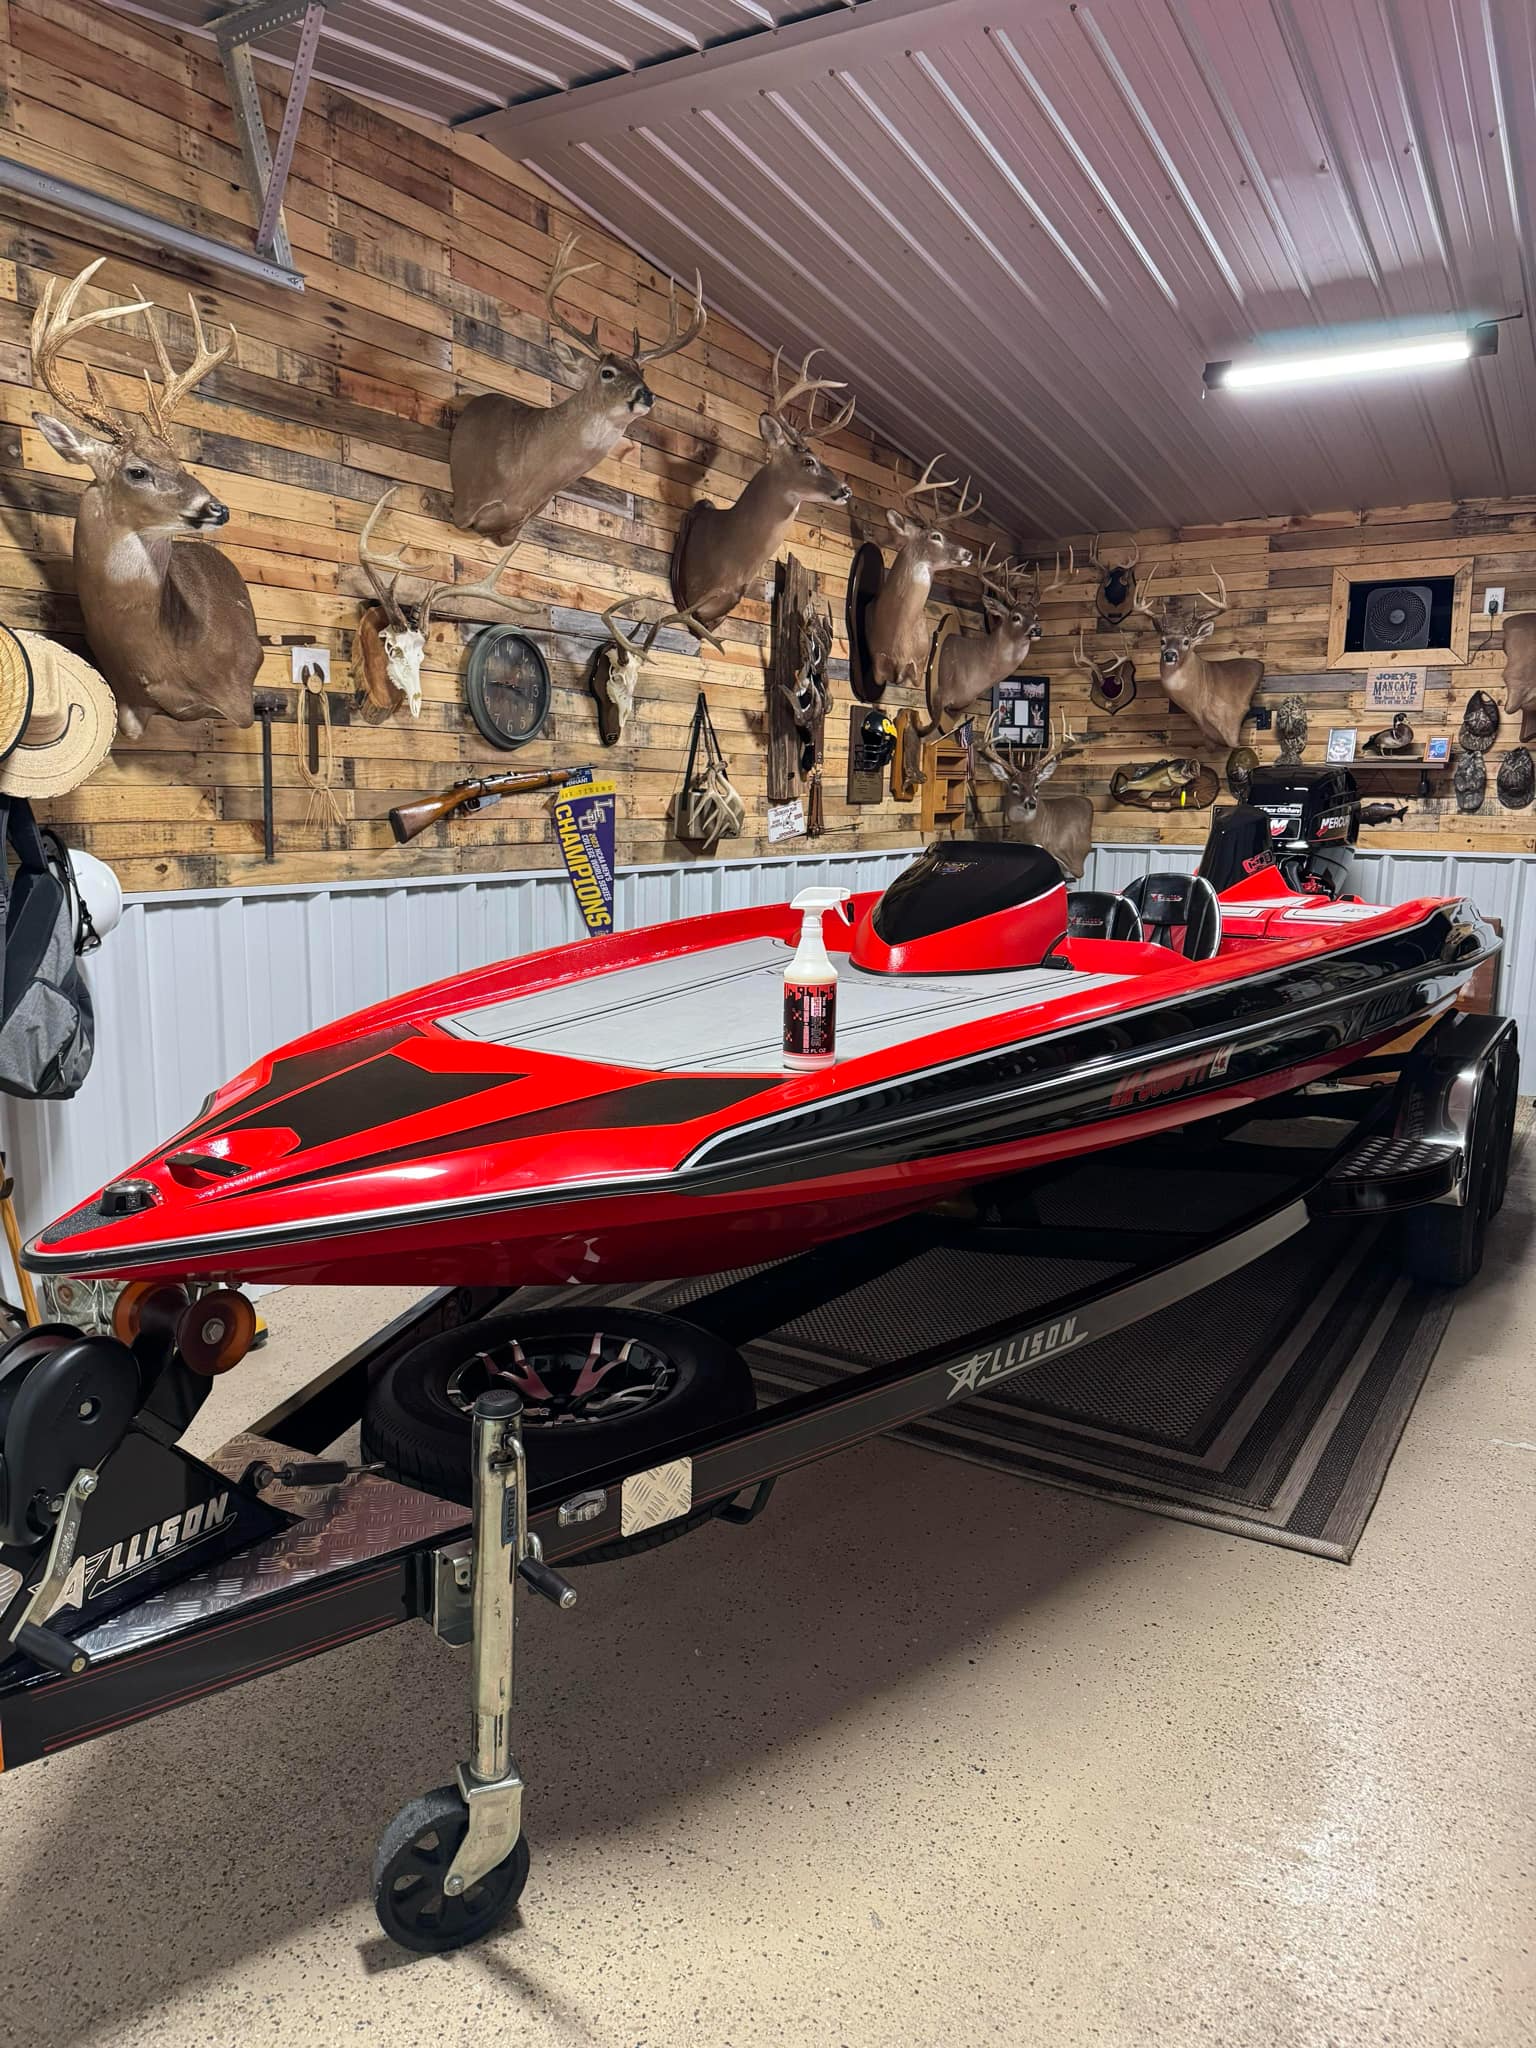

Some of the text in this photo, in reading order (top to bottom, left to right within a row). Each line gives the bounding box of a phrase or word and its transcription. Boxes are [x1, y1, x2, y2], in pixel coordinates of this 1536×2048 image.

[1373, 679, 1418, 696] MAN CAVE
[1375, 672, 1417, 680] JOEY'S
[578, 798, 613, 832] LSU
[1320, 815, 1350, 830] MERCU
[554, 804, 612, 928] CHAMPIONS
[581, 834, 613, 902] COLLEGE WORLD SERIES
[946, 1316, 1078, 1400] ALLISON
[507, 1489, 516, 1538] FULTON
[46, 1491, 230, 1618] ALLISON
